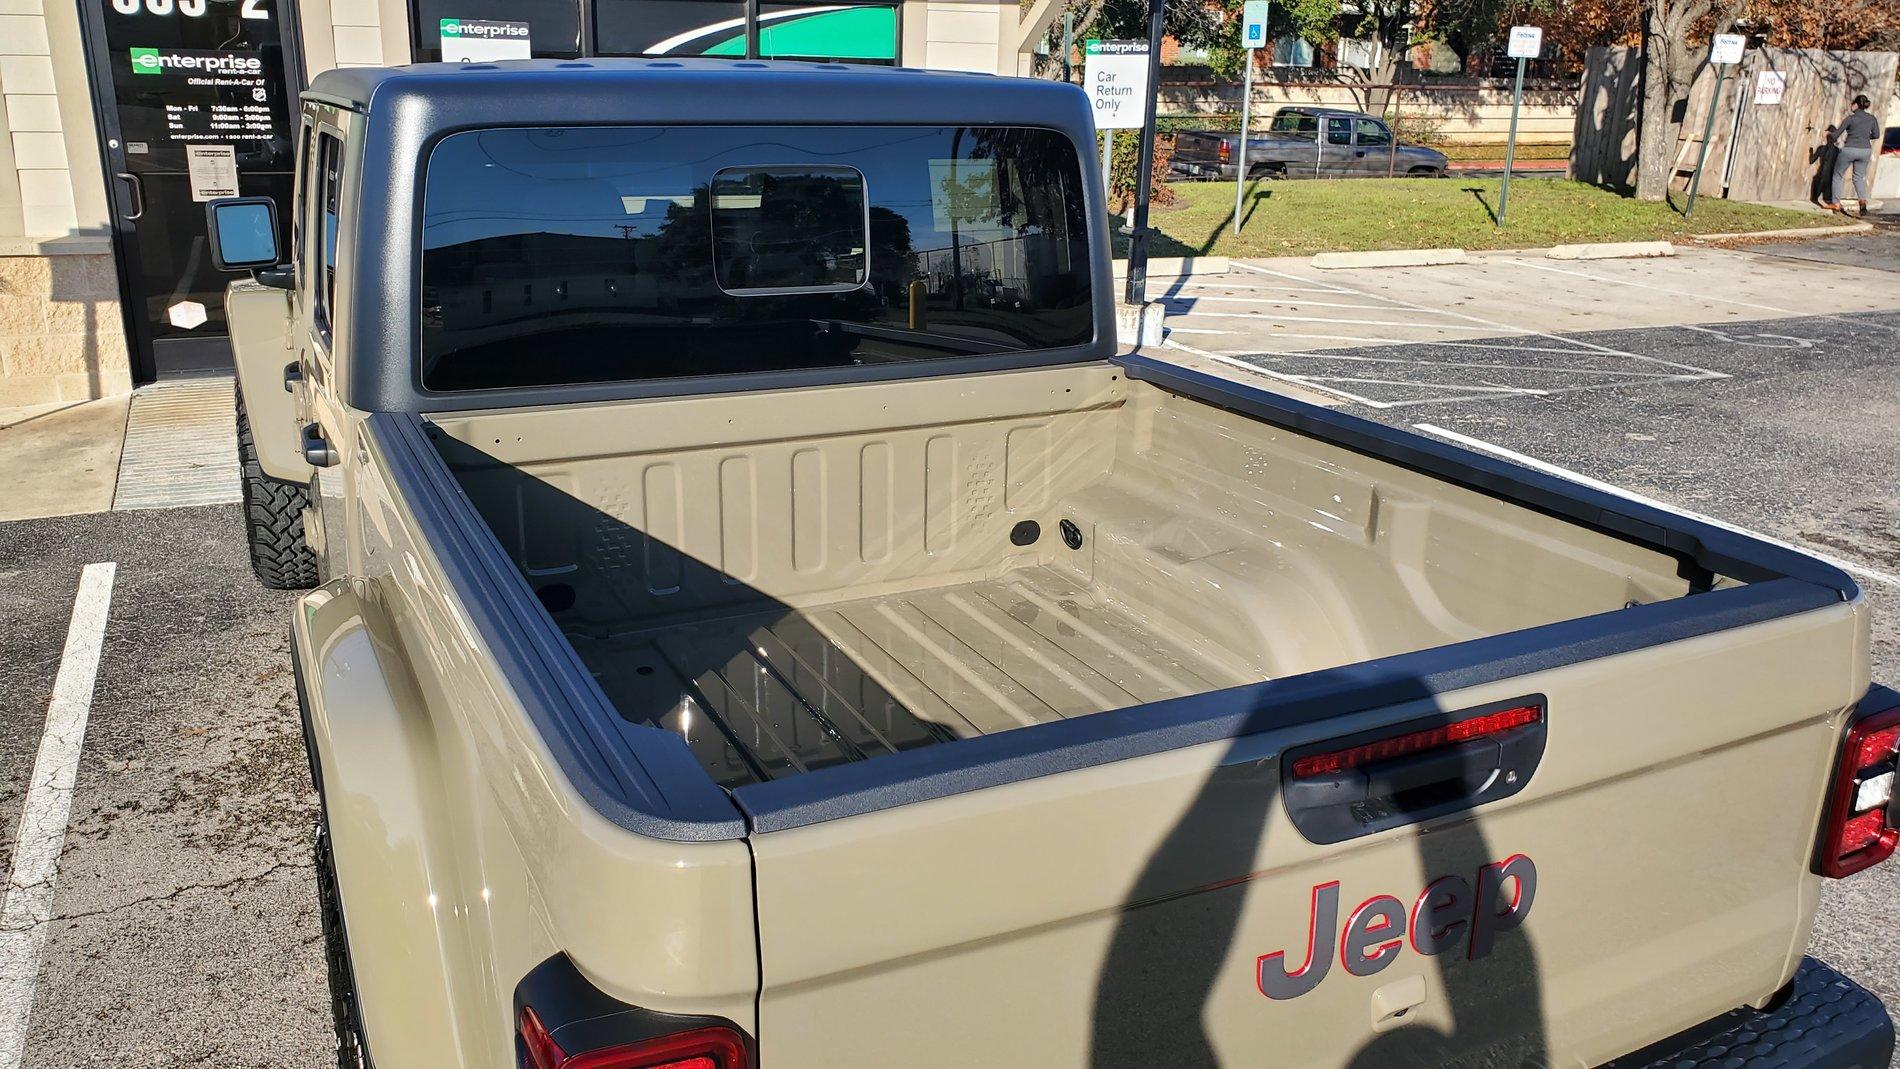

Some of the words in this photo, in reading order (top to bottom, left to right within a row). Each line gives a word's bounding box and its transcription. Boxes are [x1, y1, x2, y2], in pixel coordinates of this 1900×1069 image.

[444, 24, 529, 37] enterprise
[1089, 42, 1149, 54] enterprise
[133, 54, 261, 72] enterprise
[187, 78, 214, 86] Official
[215, 78, 255, 86] Rent-A-Car
[1097, 71, 1117, 82] Car
[1096, 86, 1132, 96] Return
[1095, 98, 1121, 112] Only
[244, 114, 271, 122] 3:00pm
[245, 122, 272, 131] 3:00pm
[1256, 853, 1537, 1000] Jeep
